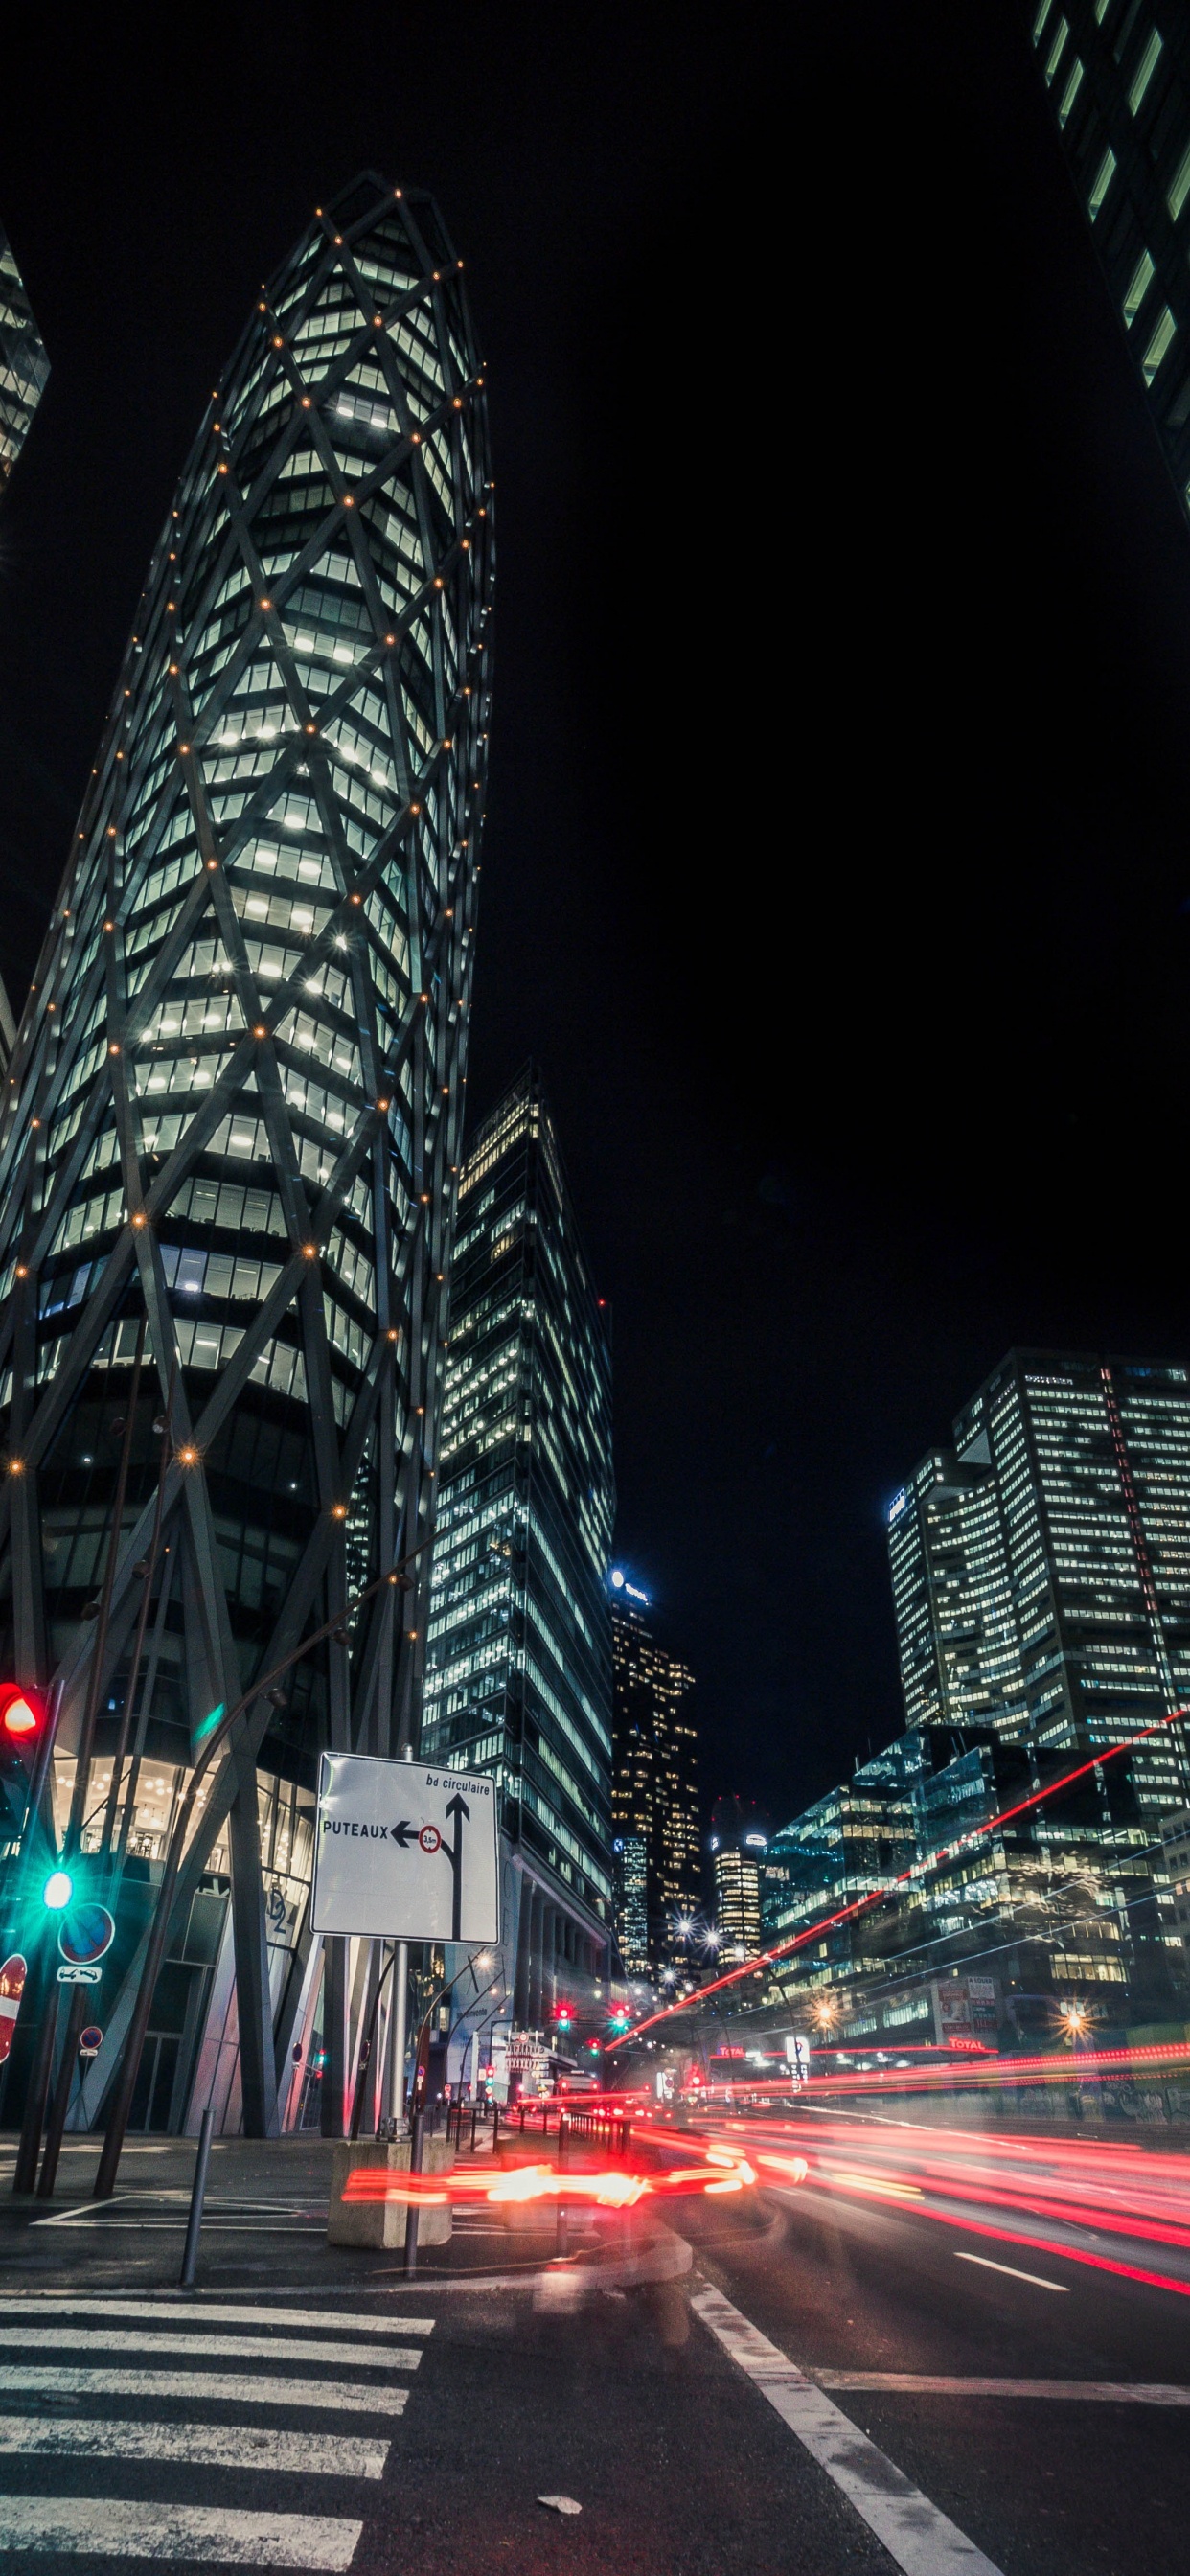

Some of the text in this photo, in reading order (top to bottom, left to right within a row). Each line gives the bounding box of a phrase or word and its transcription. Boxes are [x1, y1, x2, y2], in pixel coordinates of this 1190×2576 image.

[426, 1774, 490, 1795] bd circulaire
[323, 1821, 388, 1839] PUTEAUX
[949, 2037, 985, 2050] TOTAL
